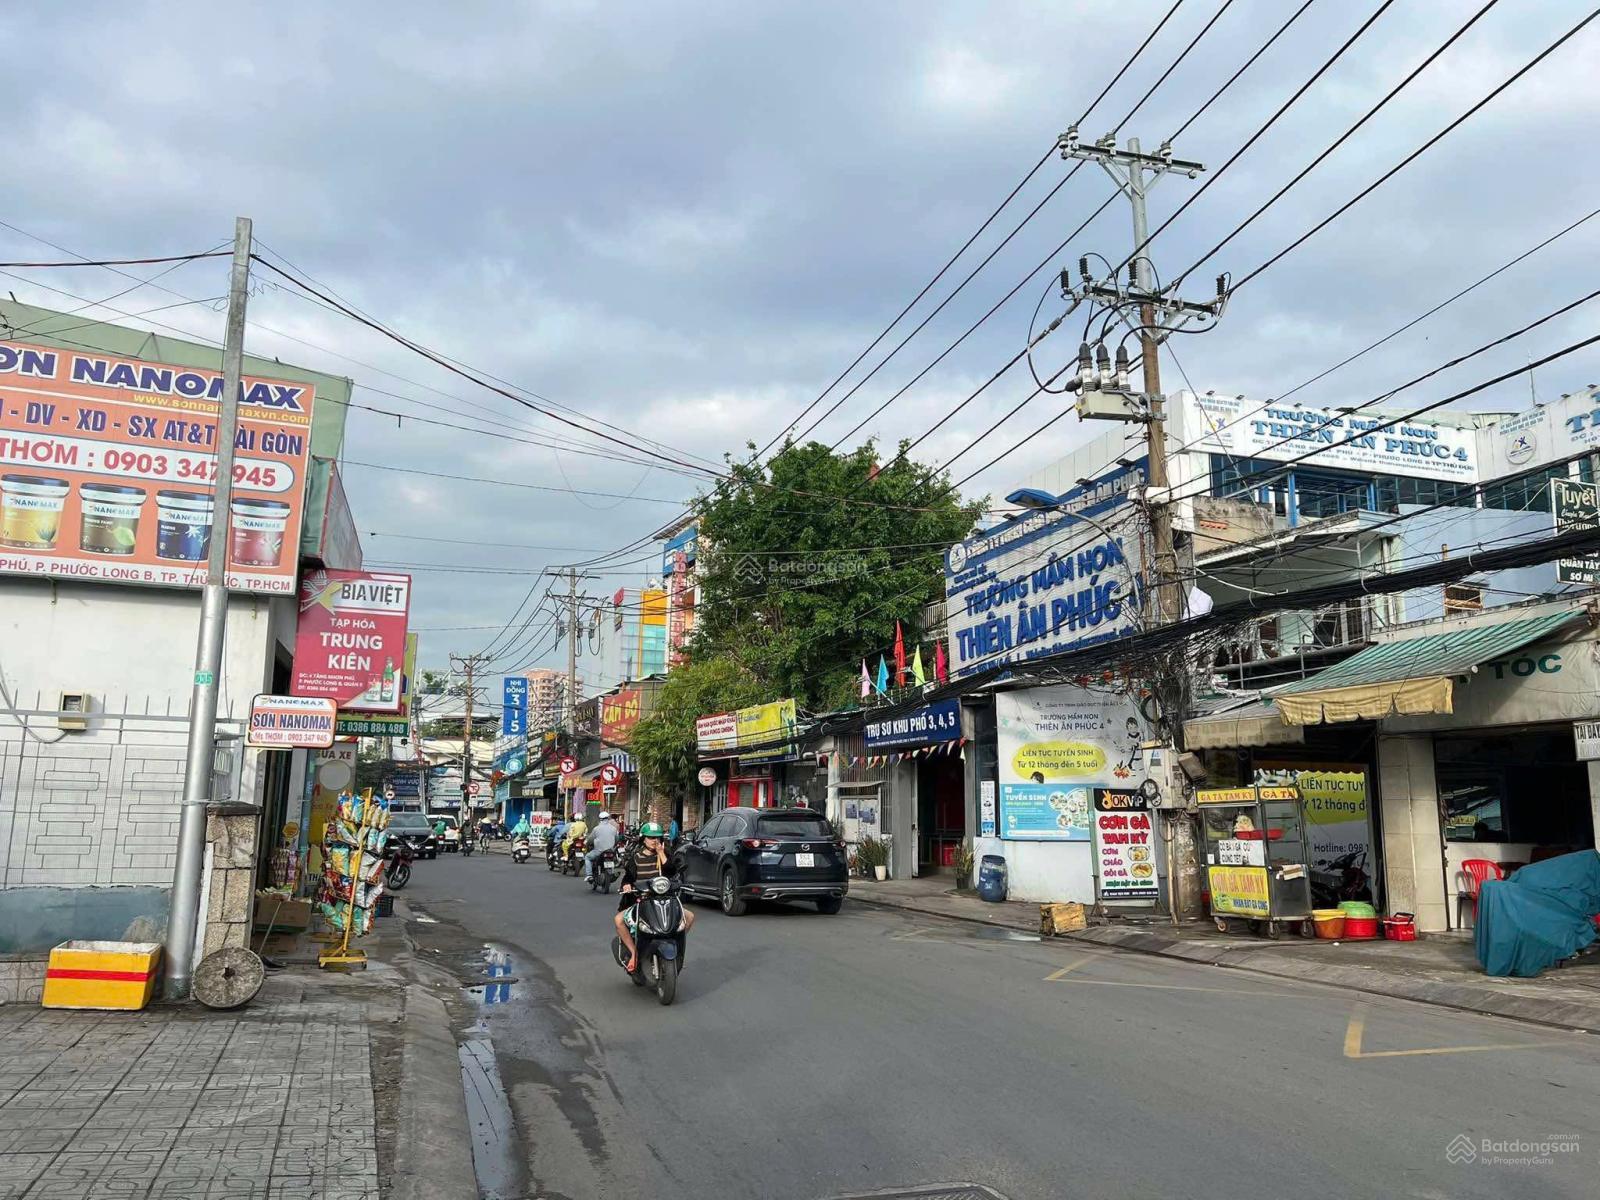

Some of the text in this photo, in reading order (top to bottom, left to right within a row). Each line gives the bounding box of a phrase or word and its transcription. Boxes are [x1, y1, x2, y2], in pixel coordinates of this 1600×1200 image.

[25, 401, 303, 456] DV XD SX AT&T ÀI GÒN
[1263, 407, 1344, 429] TRƯỜNG
[1400, 426, 1439, 440] NON
[1250, 419, 1335, 445] THIÊN
[1384, 435, 1450, 460] PHÚC
[1453, 446, 1469, 462] 4
[103, 449, 169, 476] 0903
[176, 458, 219, 481] 347
[232, 464, 277, 487] 945
[1556, 482, 1597, 509] Tuyết
[51, 562, 98, 577] PHƯỚC
[102, 567, 140, 580] LONG
[161, 572, 178, 583] TP.
[245, 578, 291, 592] TP.HCM
[965, 574, 1028, 616] TRƯỜNG
[1032, 552, 1074, 594] MẦM
[1078, 537, 1126, 578] NON
[329, 617, 376, 630] TẠP HÓA
[955, 611, 1012, 662] THIÊN
[1016, 601, 1047, 646] ÂN
[1052, 574, 1122, 636] PHÚC
[319, 632, 383, 650] TRUNG
[327, 651, 371, 671] KIÊN
[1487, 652, 1562, 680] TÓC
[253, 711, 332, 730] SƠN NANOMAX
[1084, 712, 1099, 720] NON
[347, 722, 369, 733] 0386
[388, 723, 405, 734] 488
[866, 723, 881, 740] TRỤ
[893, 718, 909, 735] KHU
[910, 711, 927, 733] PHỐ
[948, 711, 956, 727] 5
[1035, 720, 1105, 731] THIÊN ÂN PHÚC 4
[1036, 760, 1059, 770] tháng
[1301, 776, 1323, 790] LIÊN
[1326, 780, 1345, 793] TỤC
[1313, 798, 1322, 810] 12
[1325, 797, 1356, 813] tháng
[1098, 812, 1151, 830] CƠM GÀ
[1101, 847, 1119, 856] CƠM
[1314, 843, 1346, 853] Hotline:
[1348, 843, 1364, 853] 098
[1102, 858, 1123, 867] CHÁO
